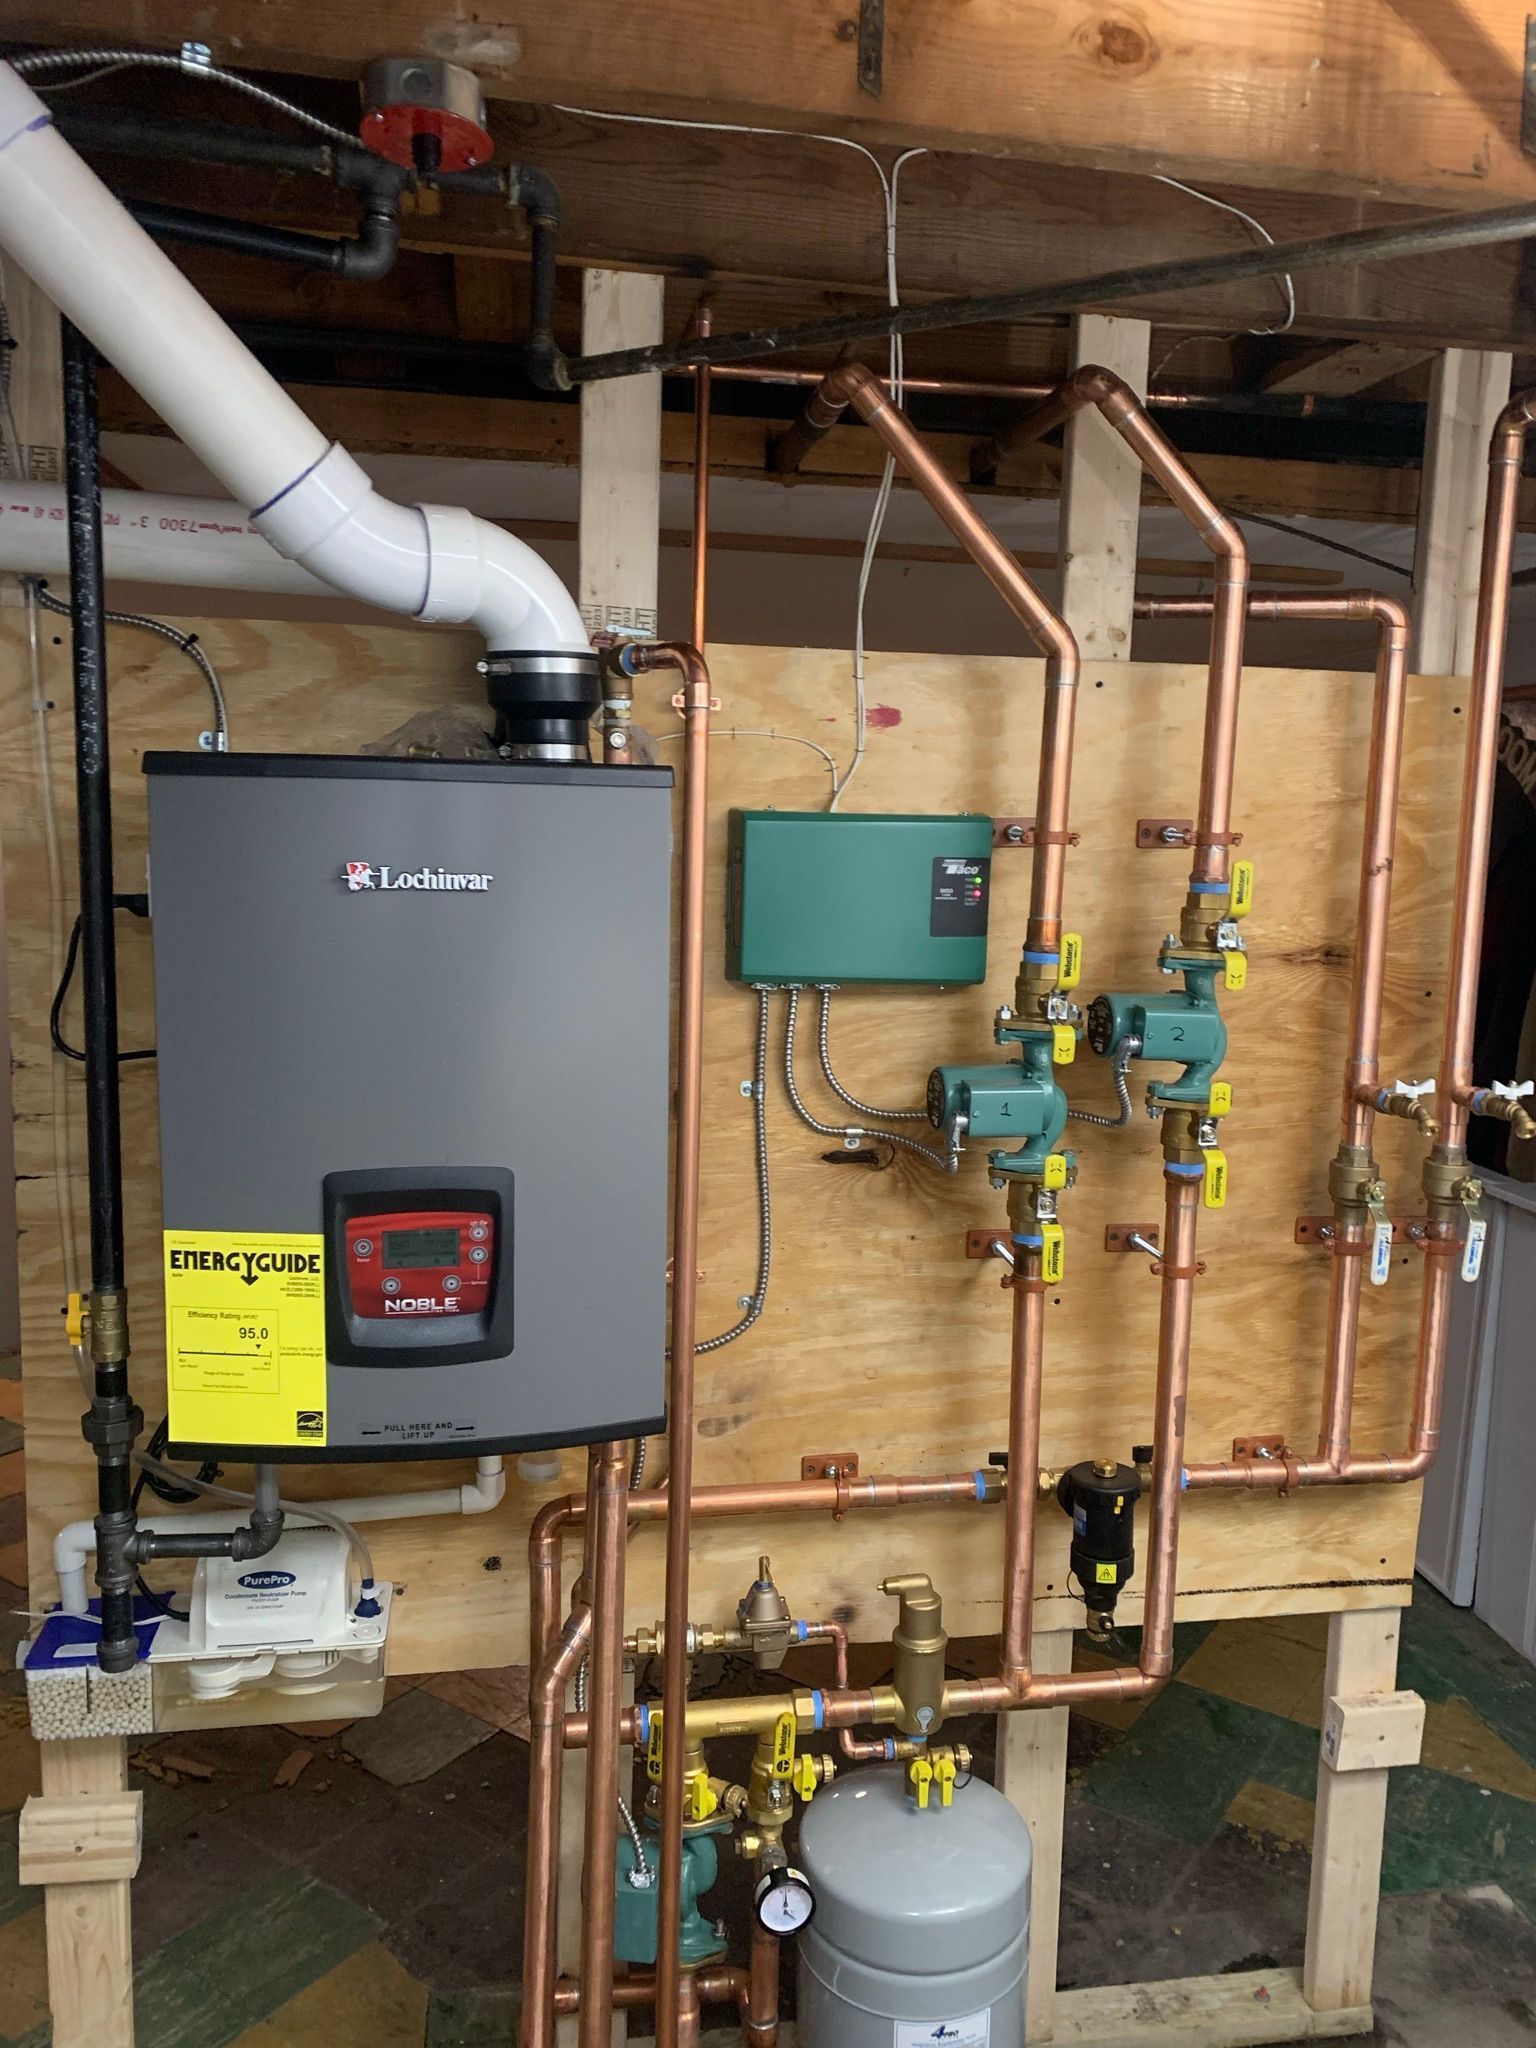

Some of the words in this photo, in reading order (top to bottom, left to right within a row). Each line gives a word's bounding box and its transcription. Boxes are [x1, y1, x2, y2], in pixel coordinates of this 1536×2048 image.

[159, 516, 198, 533] 7300
[378, 866, 494, 890] Lochinvar
[1063, 941, 1074, 978] Webstone
[1170, 1026, 1185, 1042] 2
[1000, 1101, 1012, 1117] 1
[1051, 1240, 1061, 1276] Webstone
[384, 1297, 458, 1312] NOBLE
[220, 1312, 241, 1321] Rating
[239, 1327, 268, 1339] 95.0
[384, 1424, 406, 1432] PULL
[409, 1423, 431, 1431] HERE
[435, 1422, 453, 1430] AND
[402, 1431, 420, 1440] LIFT
[423, 1431, 435, 1439] UP
[244, 1575, 290, 1586] PurePro
